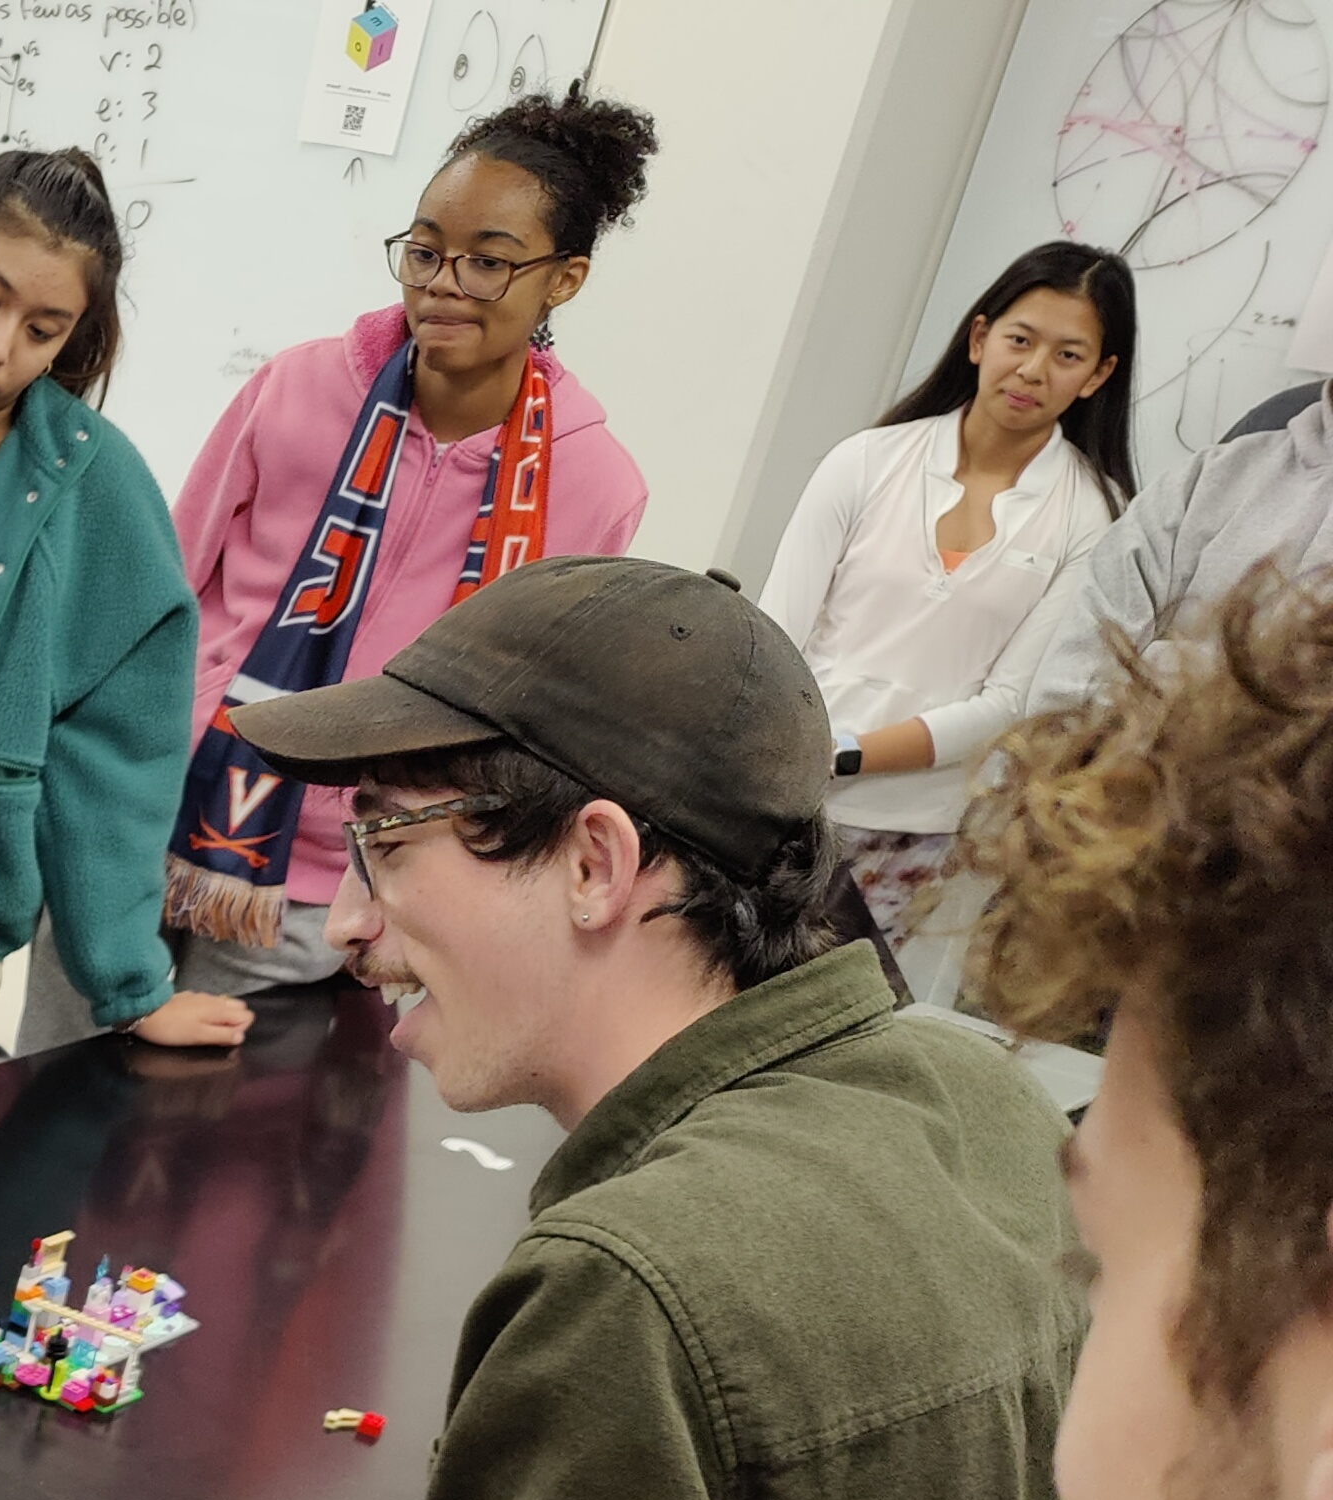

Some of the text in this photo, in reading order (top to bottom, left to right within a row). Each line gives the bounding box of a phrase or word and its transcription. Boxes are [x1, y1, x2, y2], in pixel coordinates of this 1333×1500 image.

[64, 3, 92, 22] as
[143, 43, 162, 71] 2
[141, 91, 158, 121] 3
